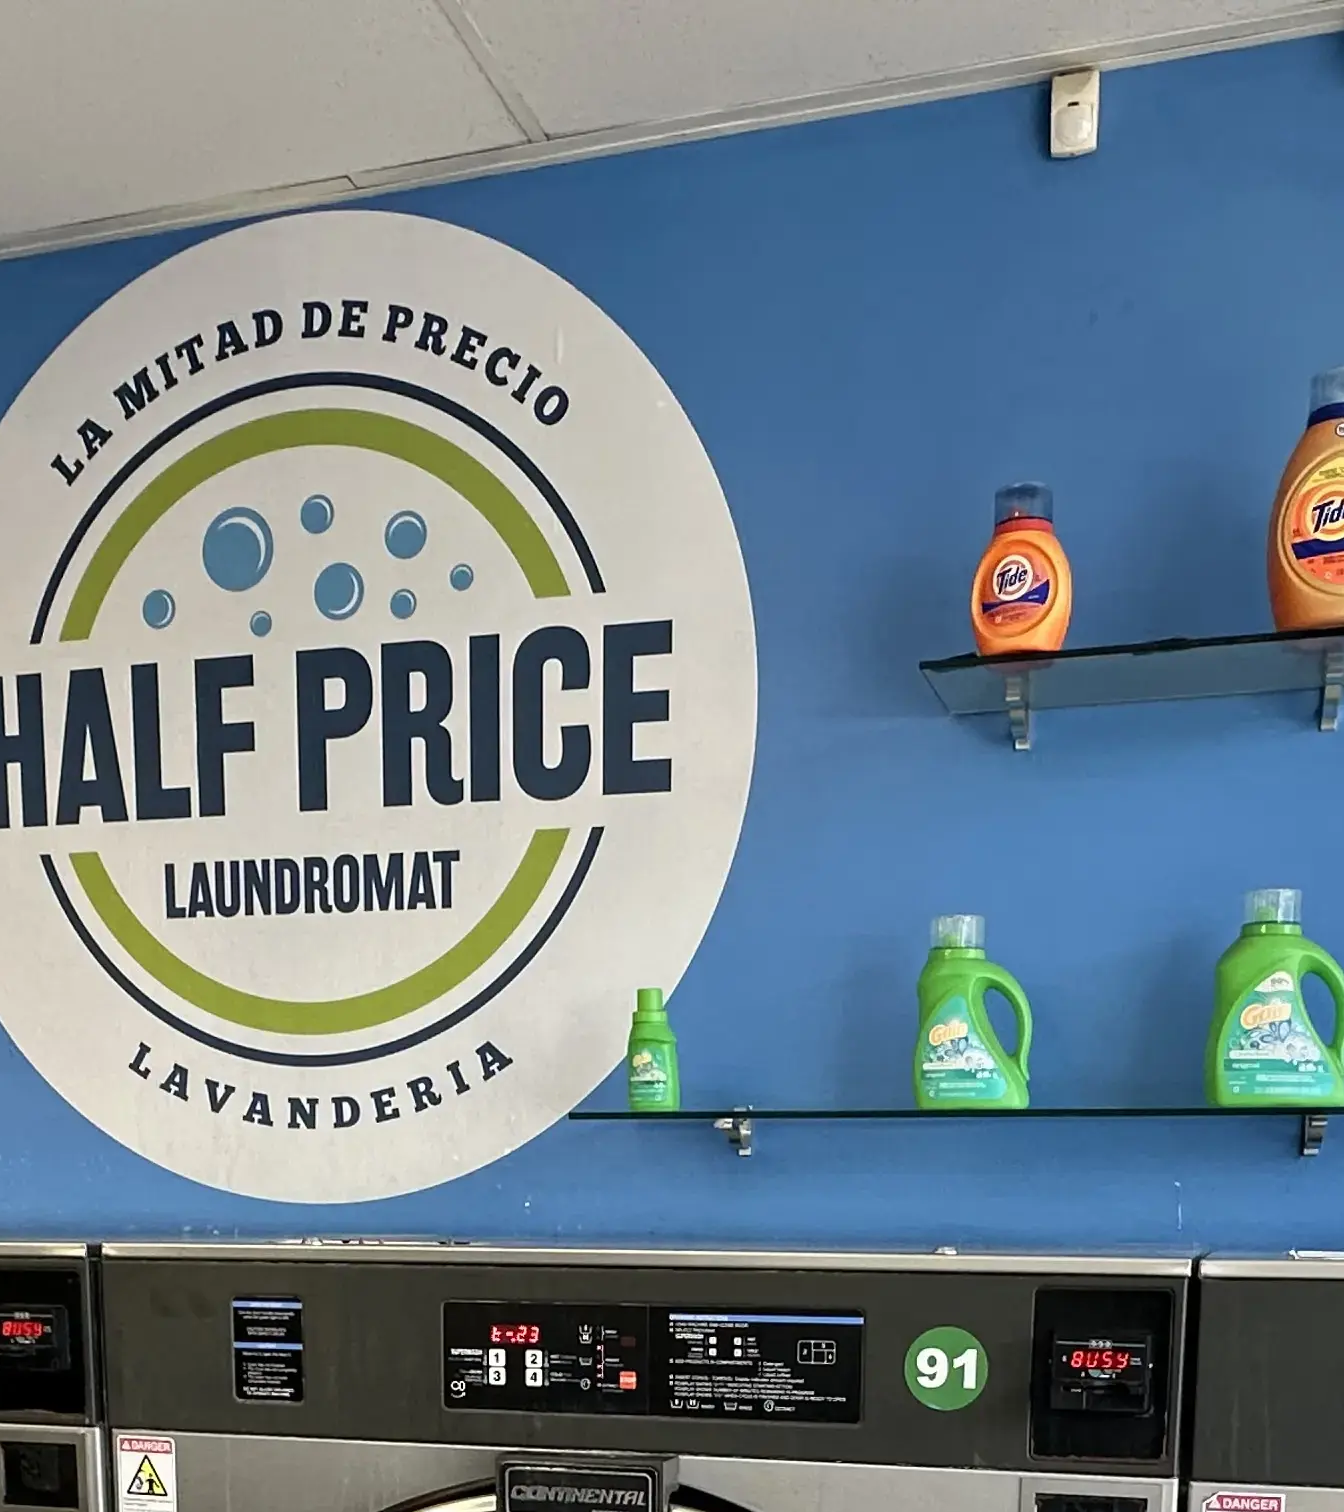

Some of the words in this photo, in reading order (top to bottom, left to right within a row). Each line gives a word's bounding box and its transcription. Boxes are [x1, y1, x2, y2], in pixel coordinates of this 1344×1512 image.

[50, 418, 113, 486] LA
[113, 309, 284, 421] MITAD
[301, 300, 369, 340] DE
[382, 303, 570, 427] PRECIO
[997, 566, 1028, 595] Tide
[296, 619, 673, 811] PRICE
[164, 849, 460, 920] LAUNDROMAT
[128, 1040, 515, 1130] LAVANDERIA
[916, 1347, 979, 1390] 91
[131, 1440, 171, 1451] DANGER
[510, 1484, 647, 1506] CONTINENTAL
[1222, 1497, 1279, 1511] DANGER
